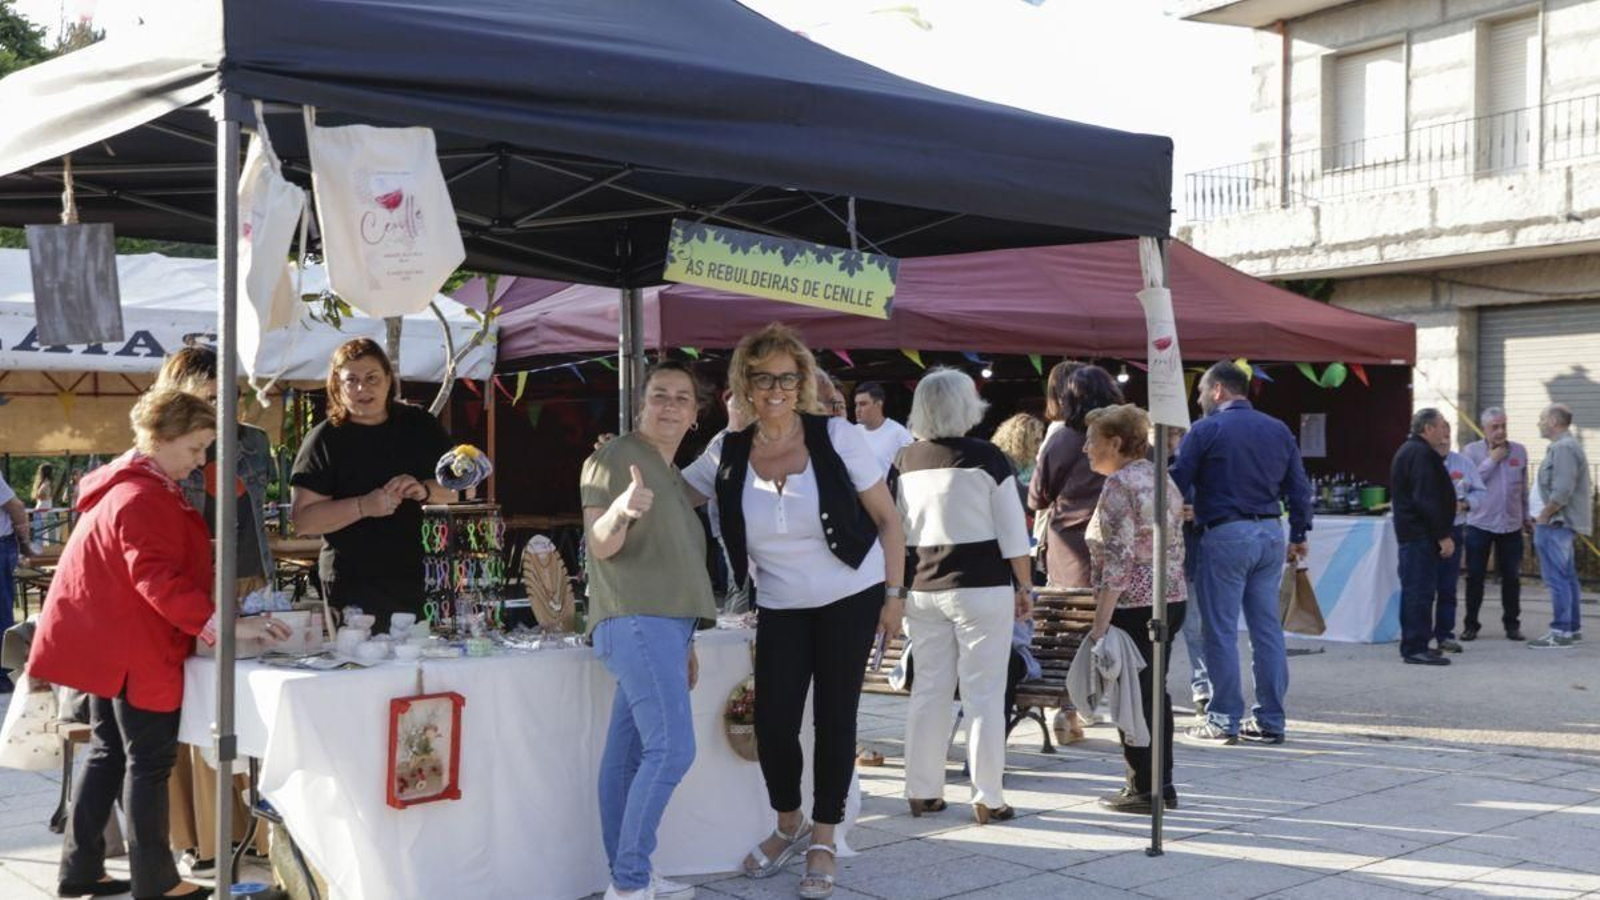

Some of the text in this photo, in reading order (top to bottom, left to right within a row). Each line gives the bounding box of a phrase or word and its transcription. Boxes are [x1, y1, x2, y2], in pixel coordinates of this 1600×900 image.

[684, 258, 875, 308] AS REBULDEIRAS DE CENLLE
